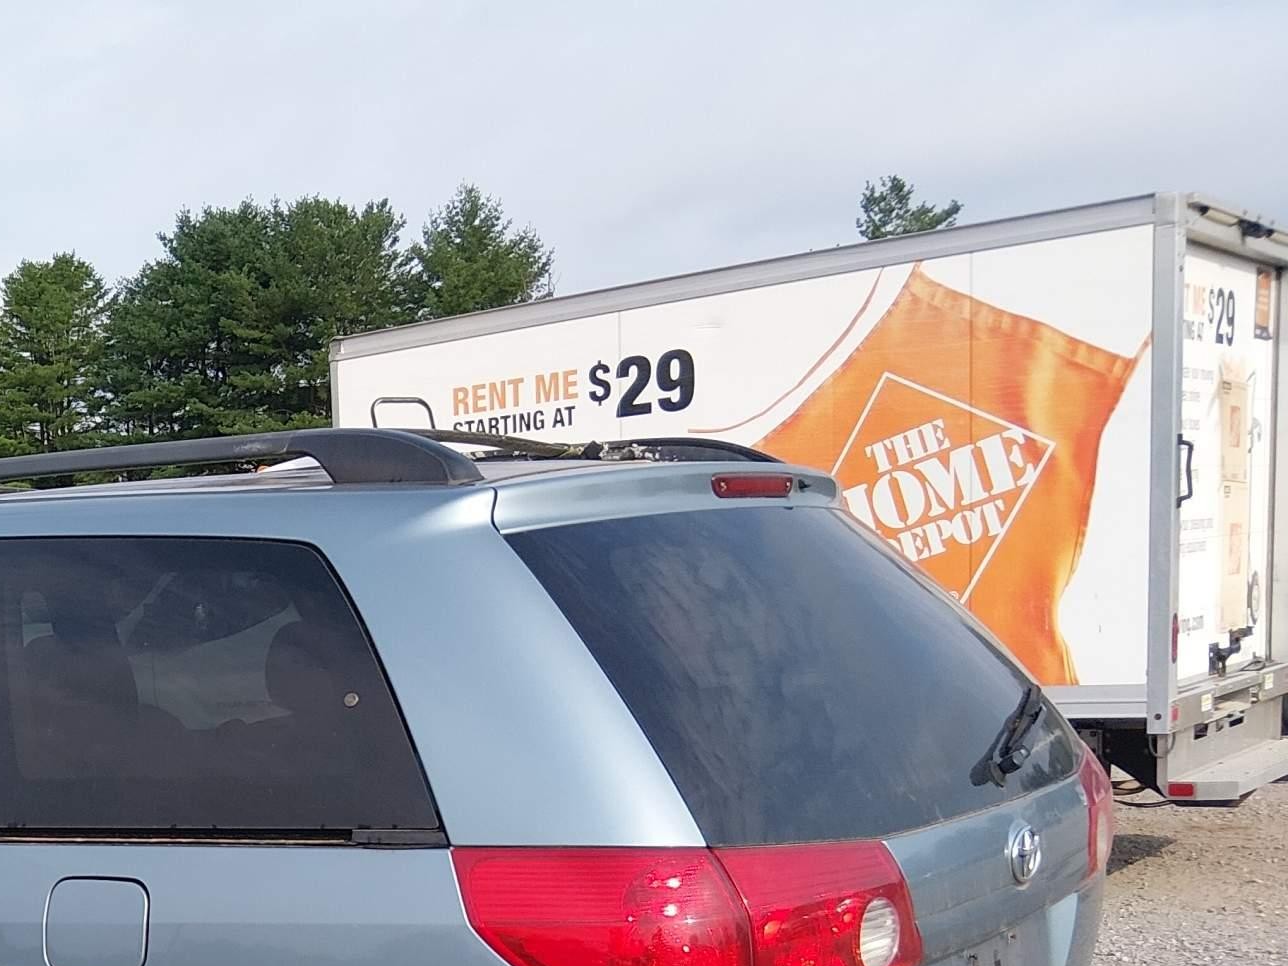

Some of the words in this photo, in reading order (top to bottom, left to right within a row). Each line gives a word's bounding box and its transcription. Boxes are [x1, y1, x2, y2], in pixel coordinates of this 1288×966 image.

[1208, 284, 1235, 347] $29
[452, 377, 525, 416] RENT
[535, 369, 578, 404] ME
[588, 349, 695, 418] $29
[552, 406, 576, 428] AT
[864, 418, 951, 473] THE
